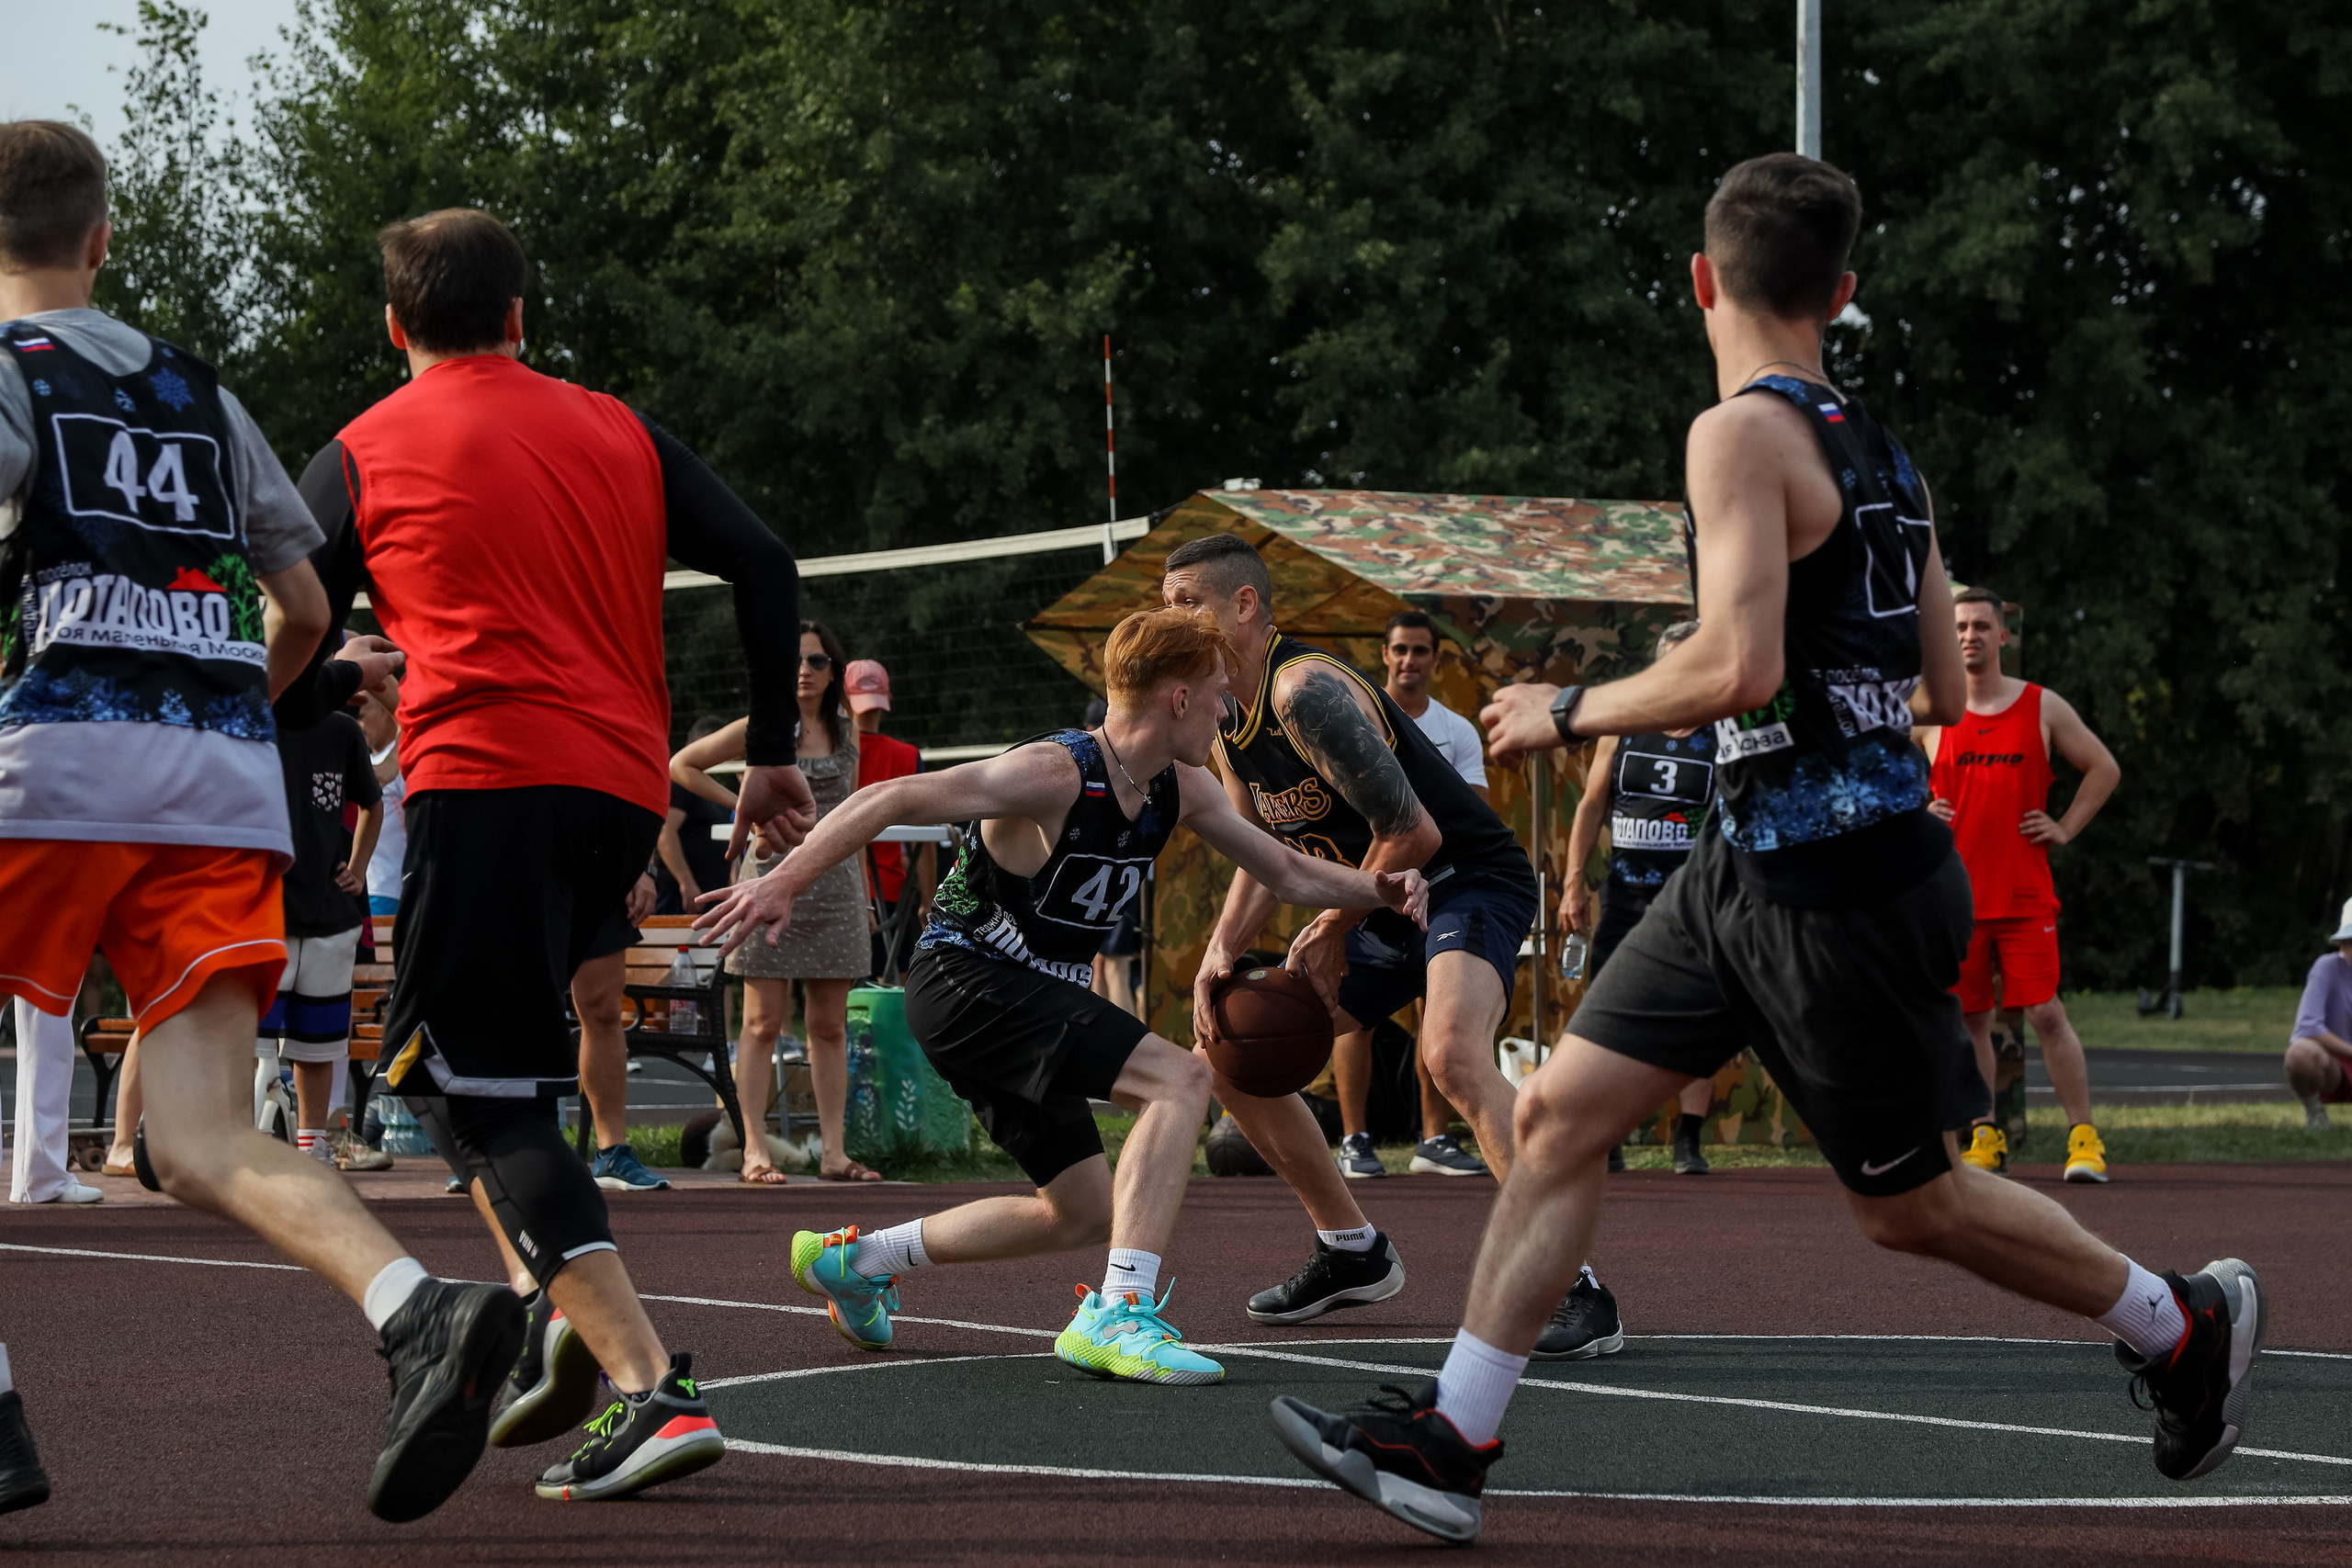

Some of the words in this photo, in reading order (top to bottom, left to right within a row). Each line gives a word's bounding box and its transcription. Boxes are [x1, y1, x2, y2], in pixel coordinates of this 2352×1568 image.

[103, 430, 200, 522] 44
[1650, 760, 1679, 795] 3
[1071, 864, 1140, 921] 42
[1335, 1232, 1365, 1242] PUMA
